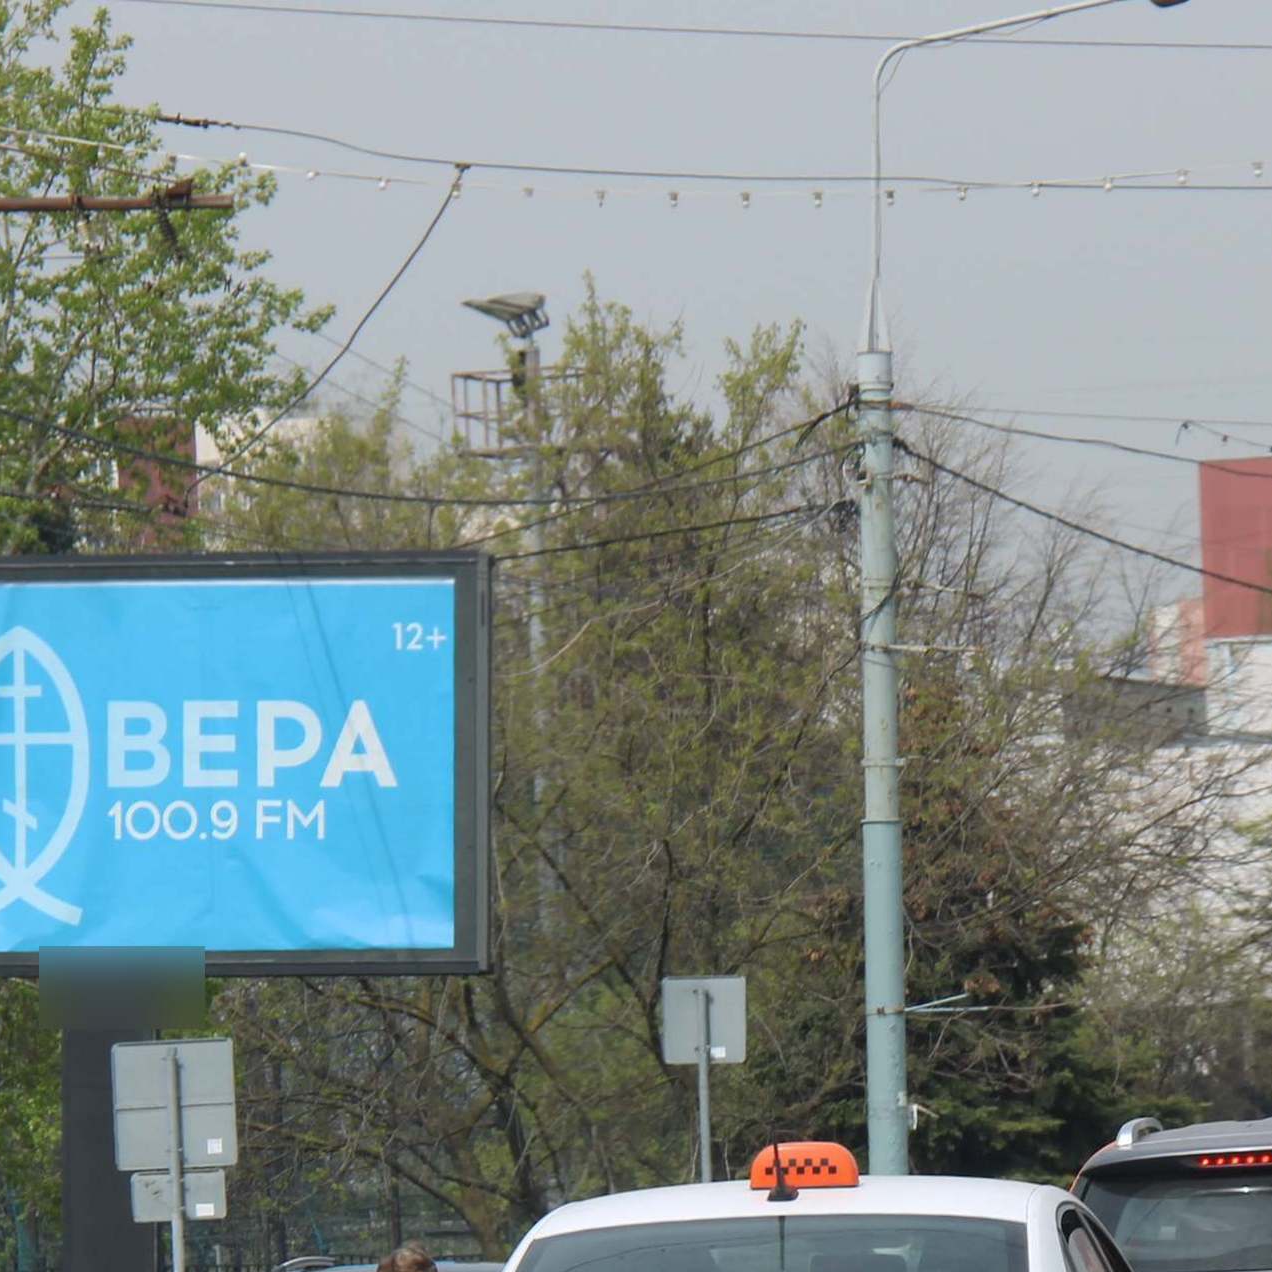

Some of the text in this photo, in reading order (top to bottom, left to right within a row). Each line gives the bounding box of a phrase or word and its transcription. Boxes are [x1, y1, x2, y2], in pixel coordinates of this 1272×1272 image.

[392, 622, 447, 651] 12+
[107, 700, 397, 787] ВЕРА
[107, 800, 326, 840] 100.9 FM
